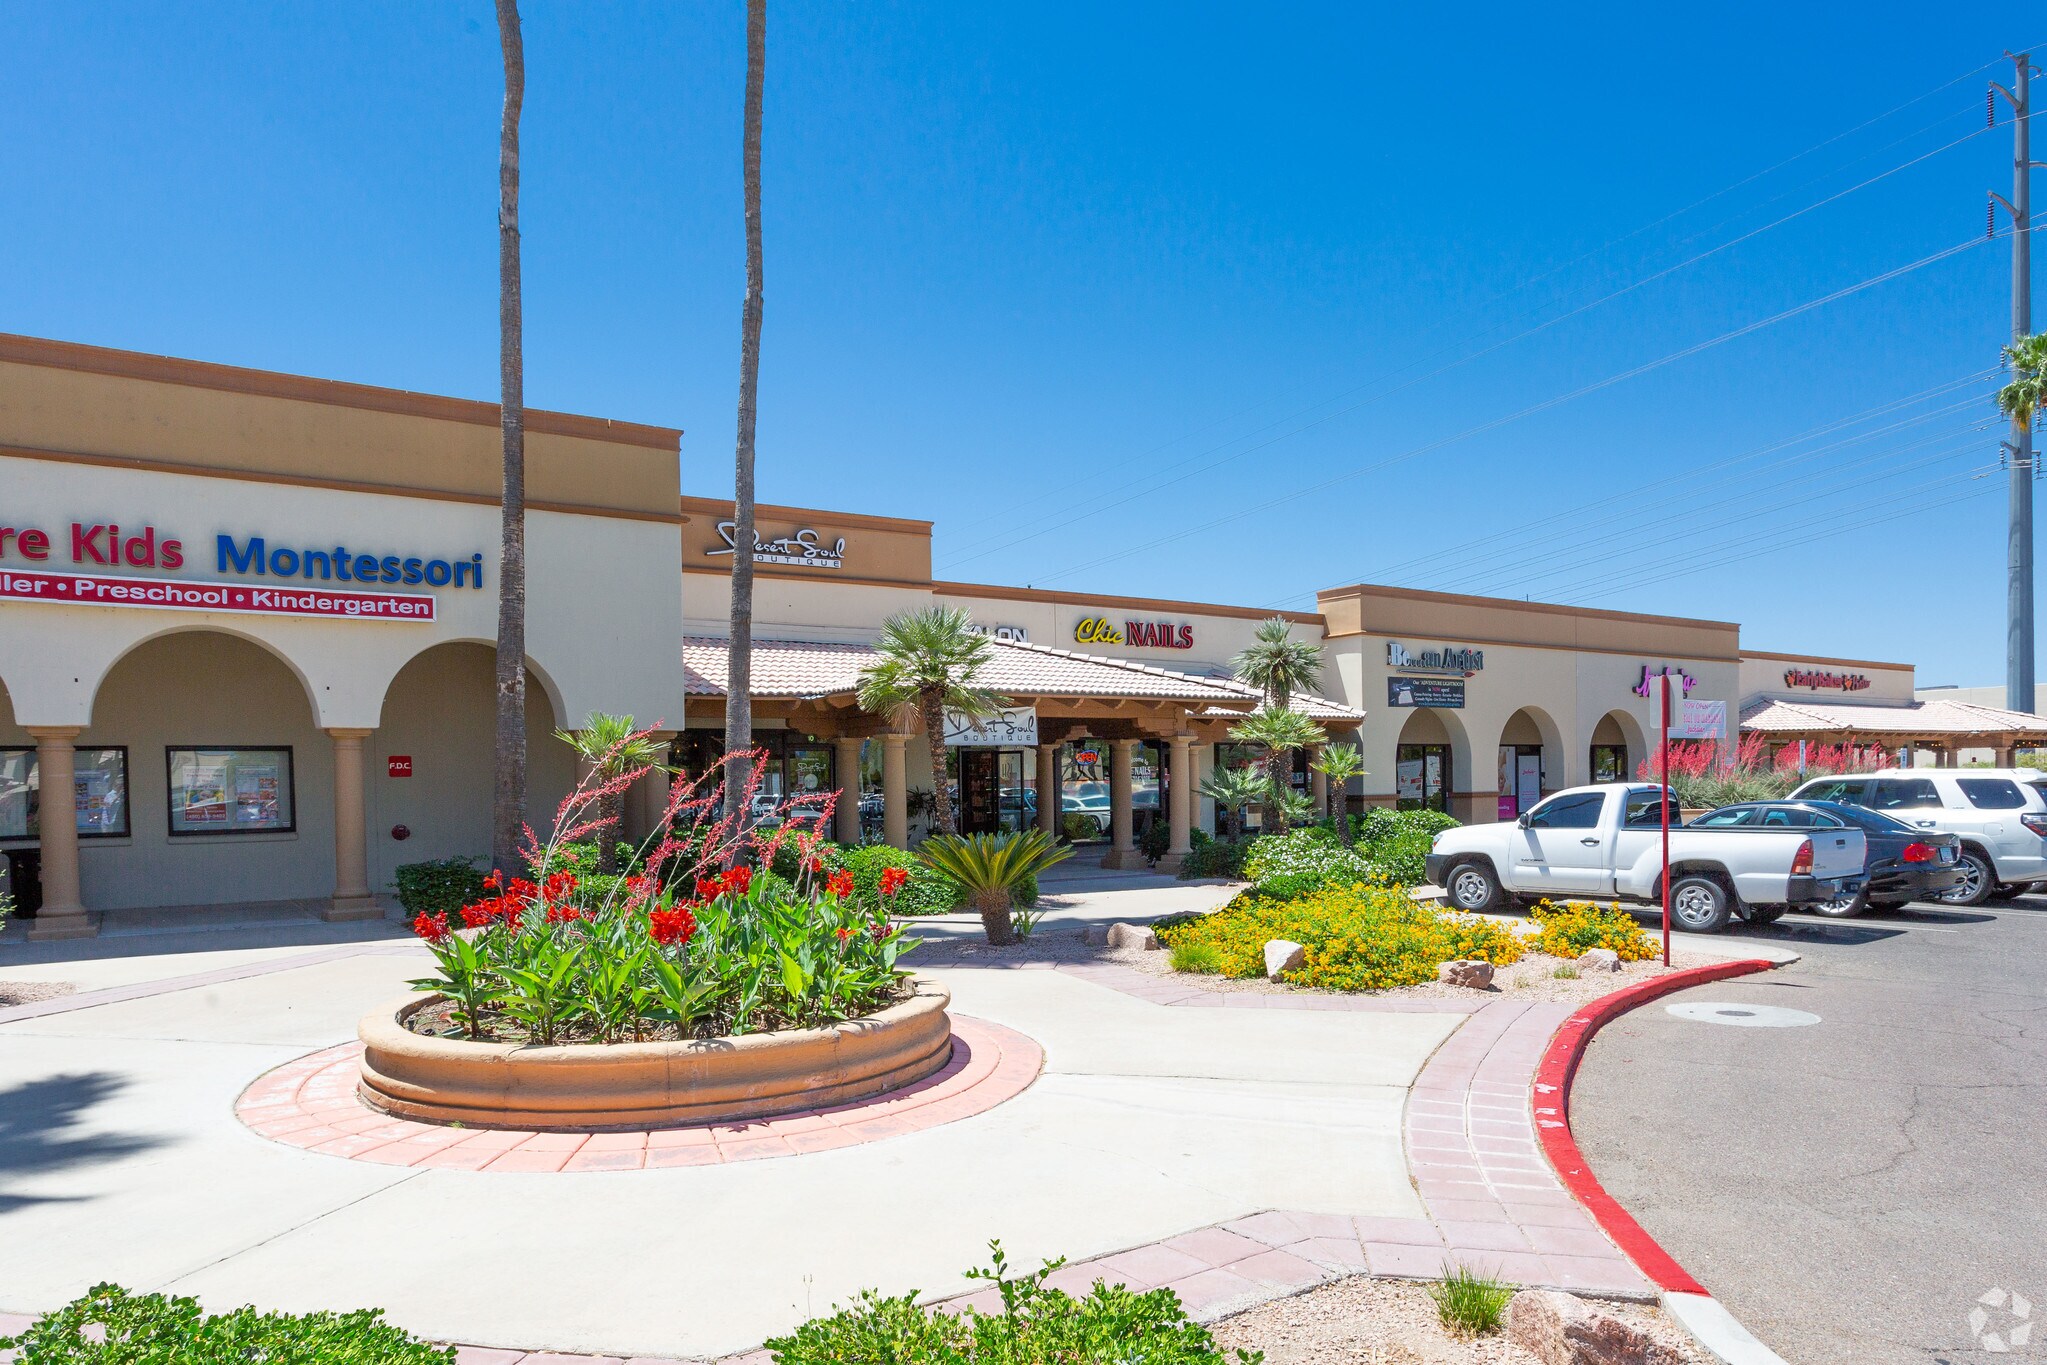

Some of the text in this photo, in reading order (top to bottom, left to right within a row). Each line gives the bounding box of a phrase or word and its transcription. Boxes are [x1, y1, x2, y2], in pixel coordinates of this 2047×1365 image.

[71, 522, 185, 569] Kids
[217, 534, 483, 589] Montessori
[796, 529, 846, 559] Soul
[754, 554, 840, 568] OUTIQUE
[0, 574, 429, 615] ler Preschool Kindergarten
[1075, 617, 1194, 649] Chic NAILS
[943, 710, 1035, 738] Deert Soul
[963, 734, 1032, 742] BOUTIQUE
[1075, 751, 1098, 763] OPEN
